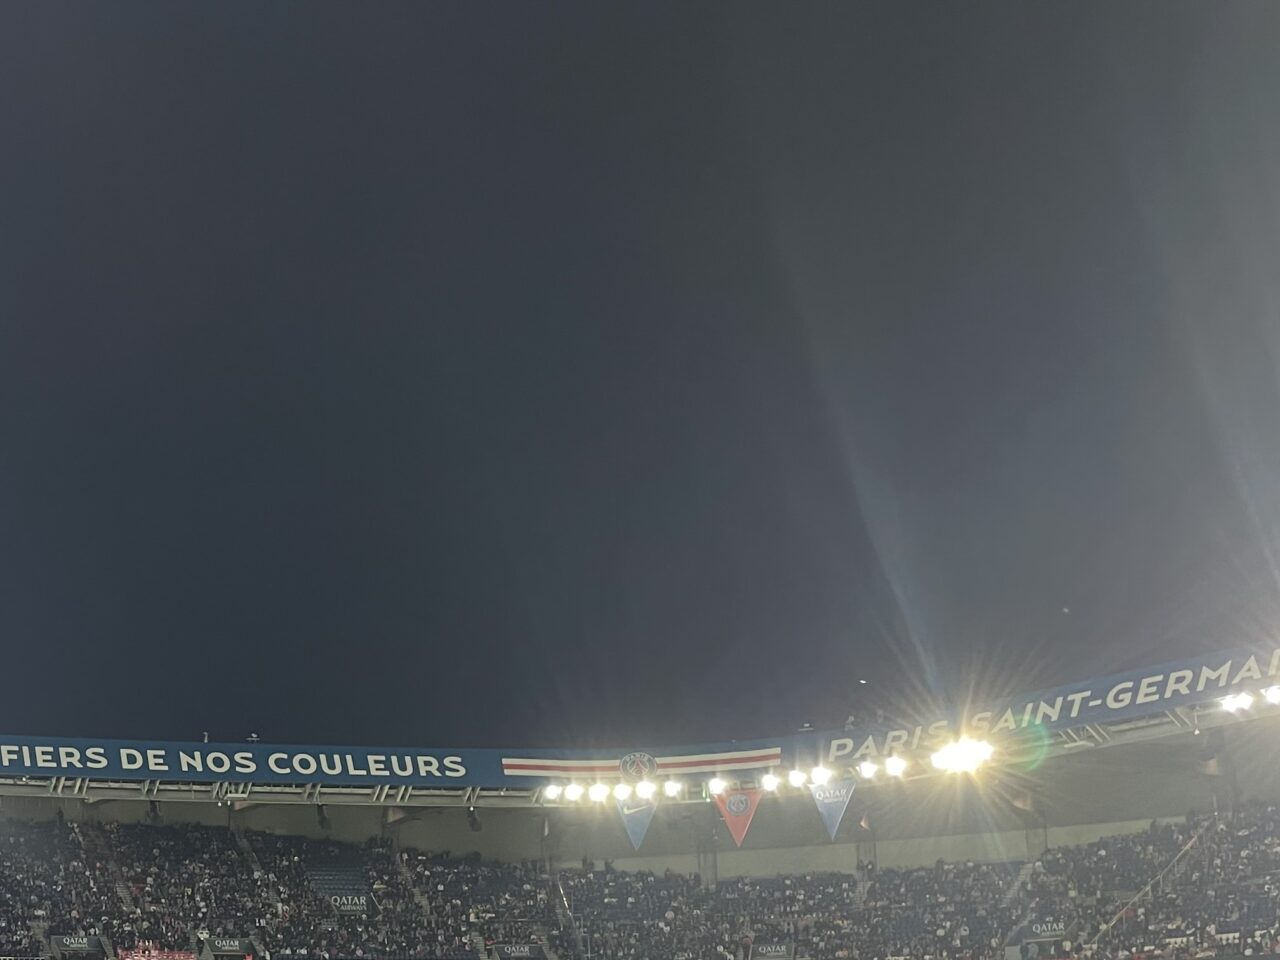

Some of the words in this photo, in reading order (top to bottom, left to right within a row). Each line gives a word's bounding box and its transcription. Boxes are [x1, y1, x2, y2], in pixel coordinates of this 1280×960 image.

[828, 719, 949, 762] PARIS
[0, 744, 109, 769] FIERS
[119, 747, 169, 771] DE
[179, 750, 257, 773] NOS
[268, 752, 467, 778] COULEURS
[815, 788, 847, 801] QATAR
[331, 895, 366, 907] QATAR
[1032, 922, 1065, 934] QATAR
[63, 936, 88, 945] QATAR
[215, 939, 239, 948] QATAR
[505, 945, 530, 954] QATAR
[758, 945, 787, 953] QATAR
